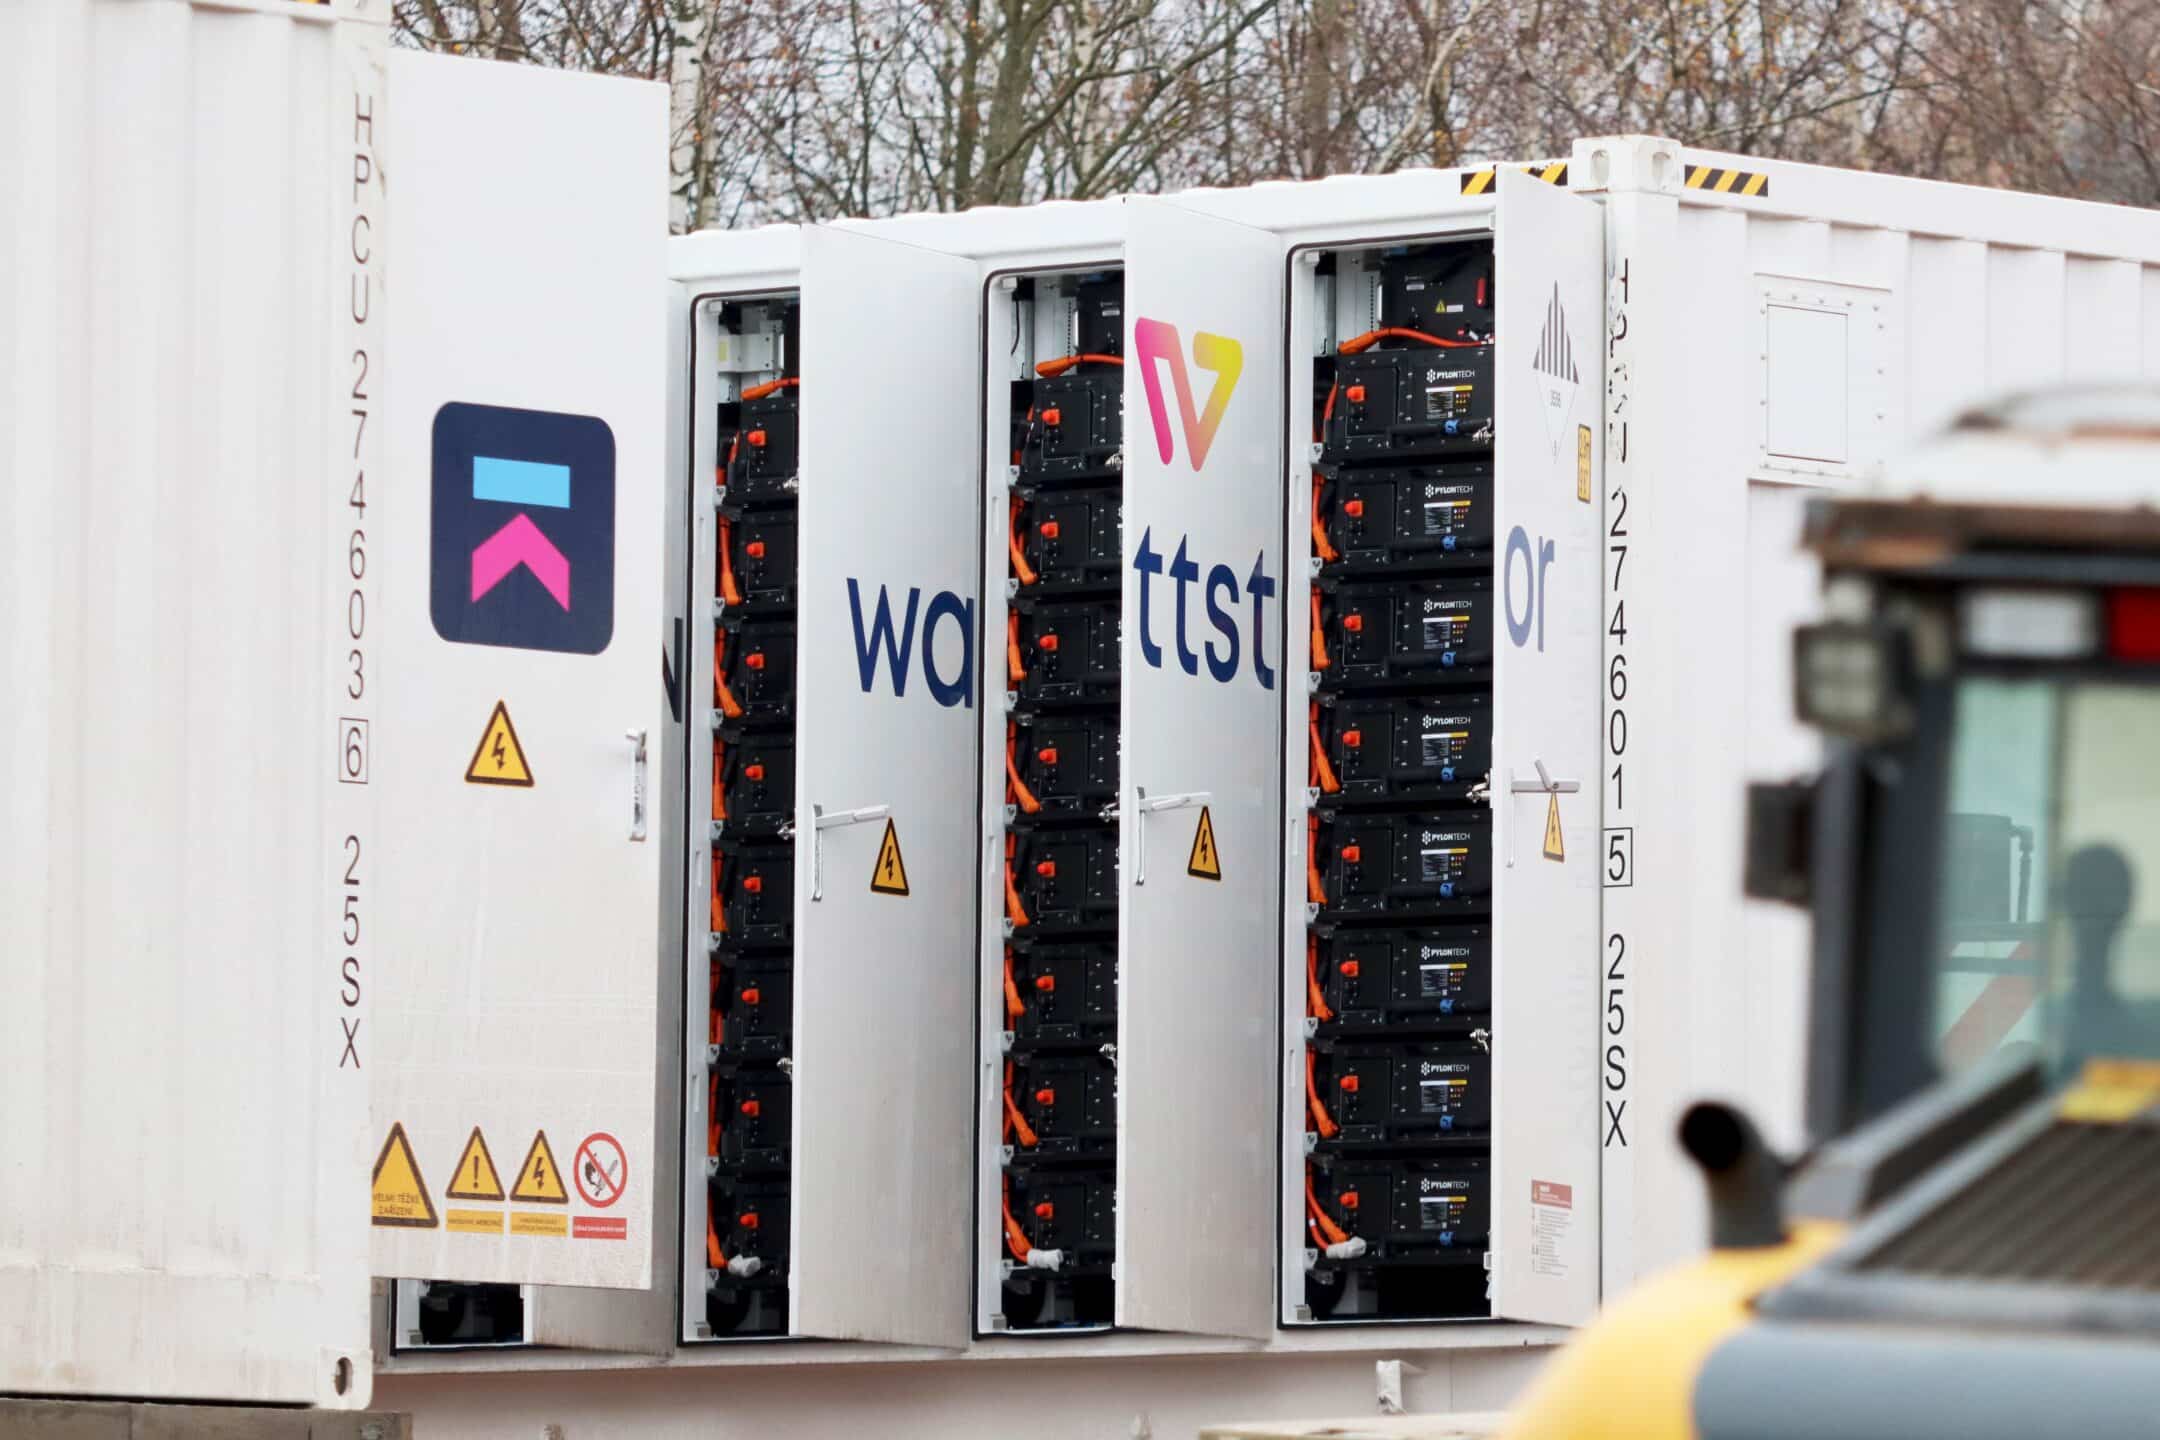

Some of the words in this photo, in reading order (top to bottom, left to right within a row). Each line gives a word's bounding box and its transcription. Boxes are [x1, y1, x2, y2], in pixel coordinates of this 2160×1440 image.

[351, 93, 373, 325] HPCU
[1436, 369, 1476, 381] PYLONTECH
[1434, 484, 1474, 496] PYLONTECH
[347, 349, 369, 700] 274603
[1433, 600, 1472, 610] PYLONTECH
[1609, 485, 1628, 811] 274601
[1432, 715, 1471, 726] PYLONTECH
[345, 729, 364, 778] 6
[1431, 831, 1471, 842] PYLONTECH
[1608, 834, 1626, 882] 5
[340, 834, 361, 1069] 25SX
[1430, 947, 1470, 957] PYLONTECH
[1606, 933, 1627, 1148] 25SX
[1430, 1063, 1470, 1074] PYLONTECH
[1430, 1179, 1470, 1190] PYLONTECH
